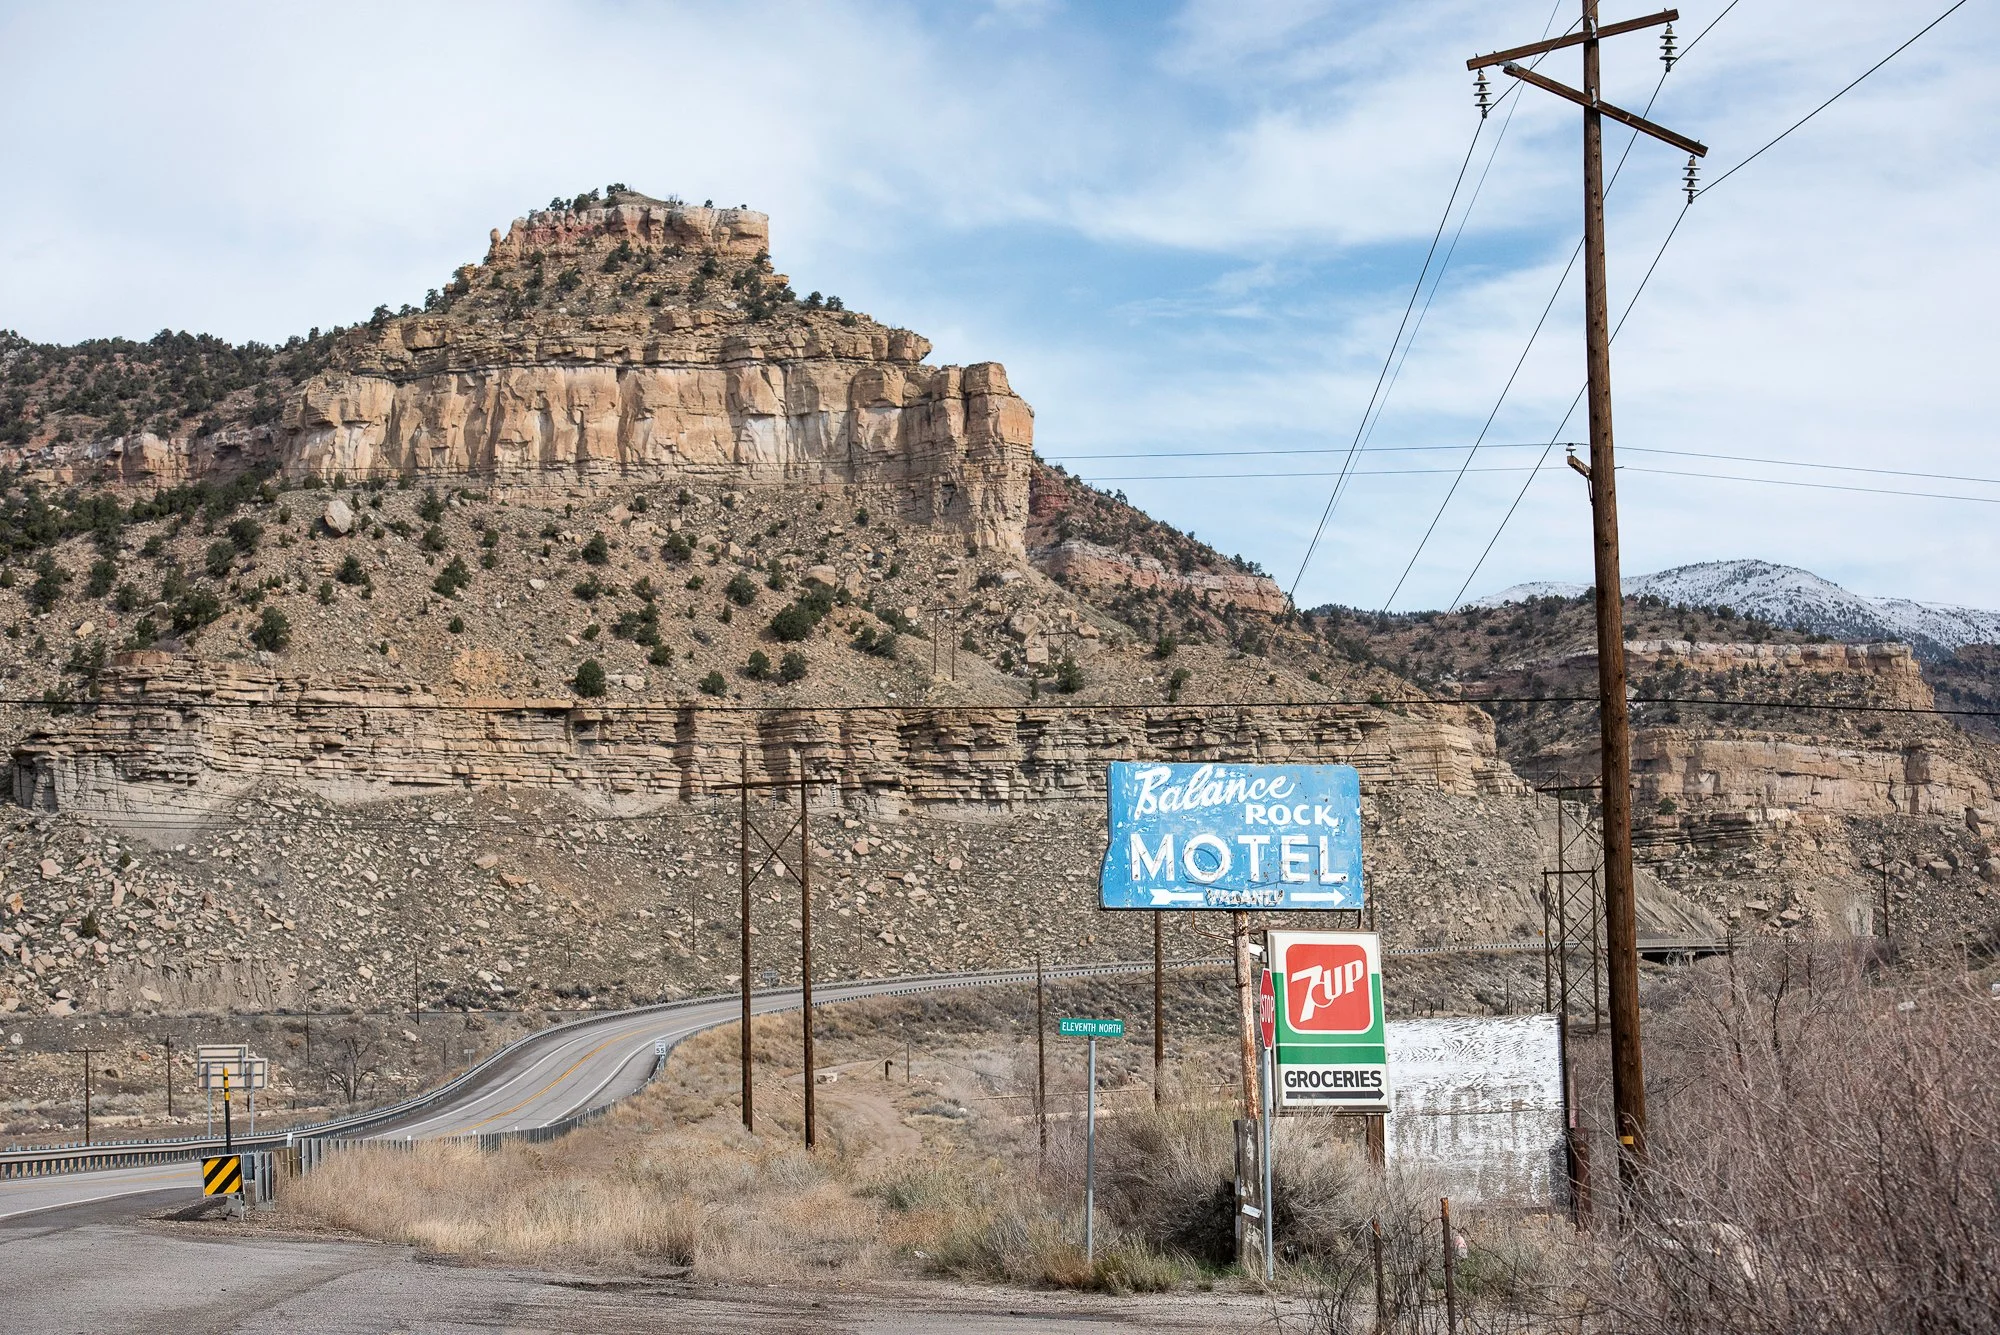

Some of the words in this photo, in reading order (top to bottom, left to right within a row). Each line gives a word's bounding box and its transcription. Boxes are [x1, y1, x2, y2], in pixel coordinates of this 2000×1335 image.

[1134, 765, 1296, 820] Balance
[1245, 804, 1339, 826] ROCK
[1130, 833, 1348, 883] MOTEL
[1261, 994, 1274, 1024] STOP
[1062, 1021, 1096, 1033] ELEVENTH
[1099, 1023, 1122, 1034] NORTH
[1284, 1070, 1382, 1088] GROCERIES
